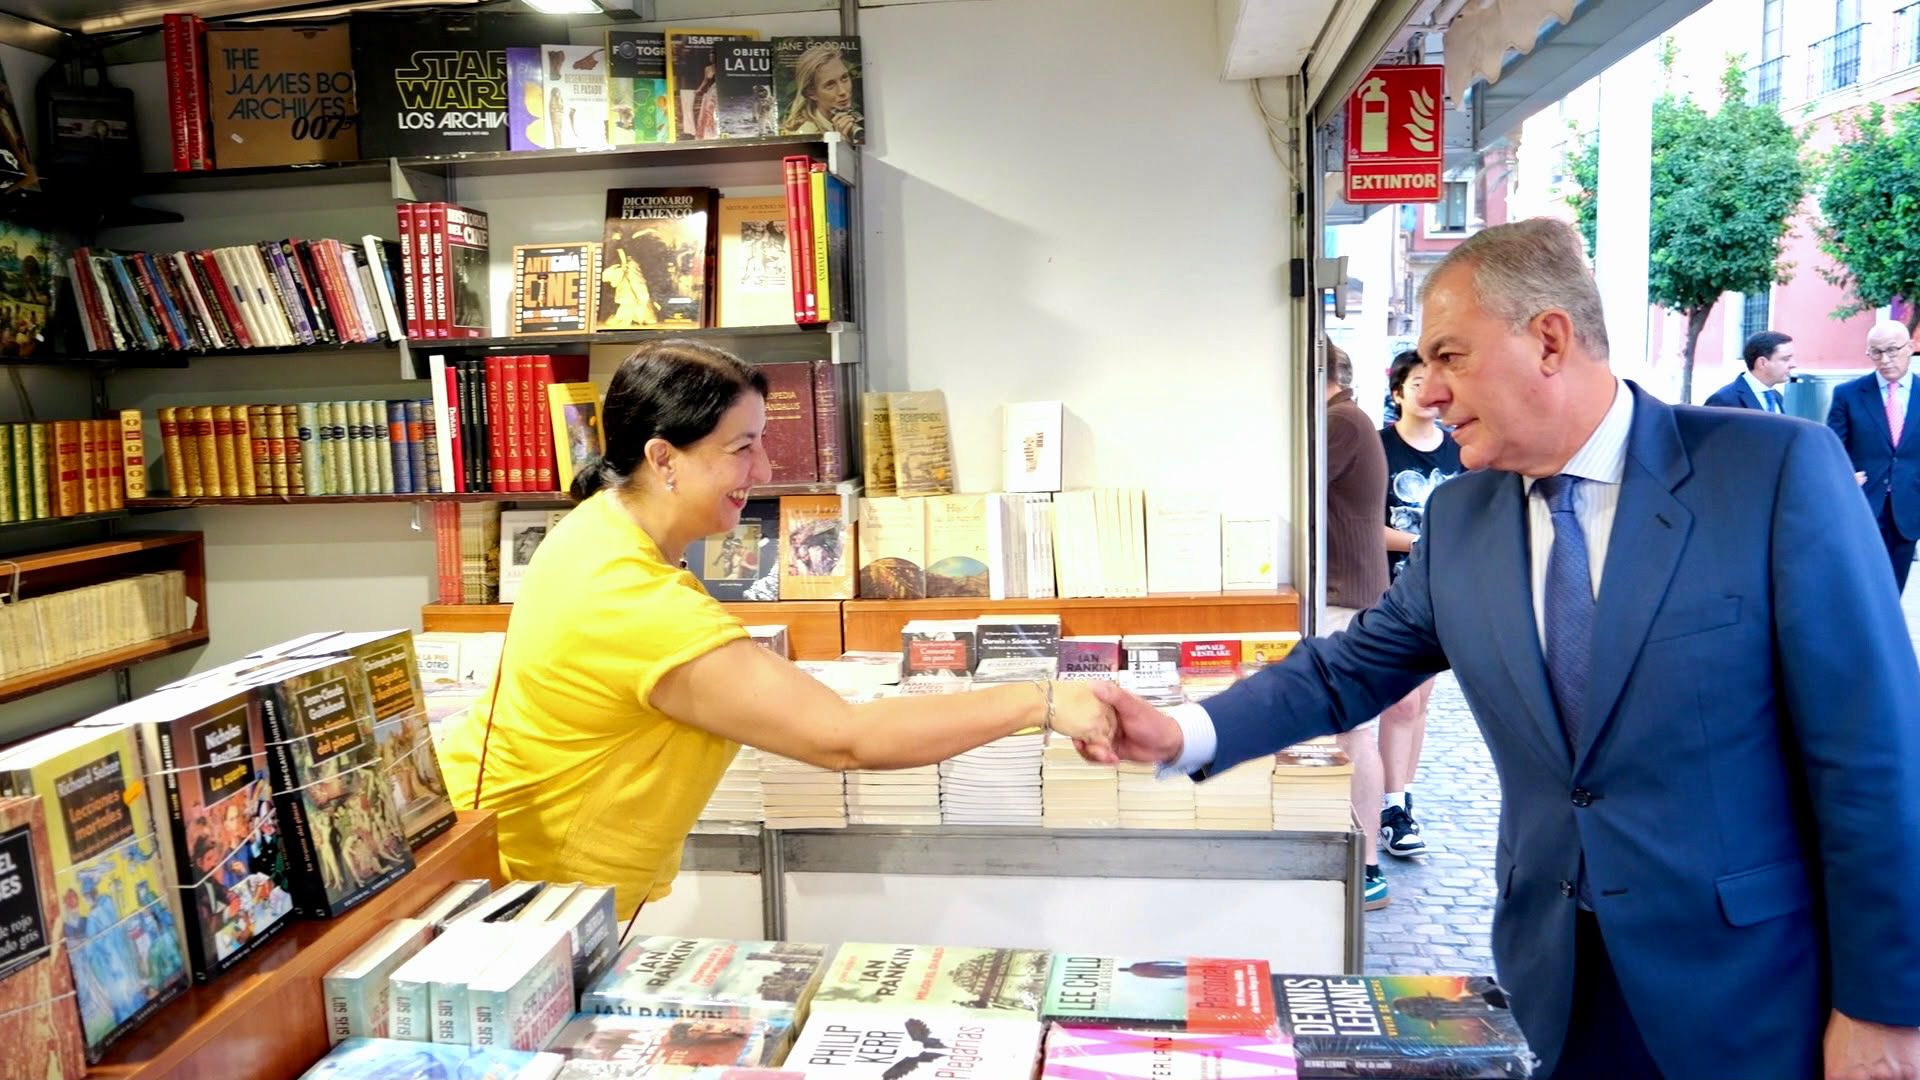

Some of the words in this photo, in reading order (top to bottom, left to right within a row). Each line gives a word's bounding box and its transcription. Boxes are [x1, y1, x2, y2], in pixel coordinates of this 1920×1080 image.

[776, 42, 803, 51] JANE
[806, 42, 858, 51] GOODALL
[222, 48, 260, 70] THE
[724, 58, 745, 71] LA
[225, 73, 311, 95] JAMES
[228, 97, 346, 120] ARCHIVES
[291, 116, 346, 140] 007
[398, 112, 435, 130] LOS
[1351, 174, 1437, 190] EXTINTOR
[623, 195, 693, 207] DICCIONARIO
[447, 208, 488, 229] HISTORIA
[621, 208, 692, 220] FLAMENCO
[401, 233, 410, 255] CINE
[420, 233, 429, 255] CINE
[433, 233, 442, 255] CINE
[447, 223, 464, 236] DEL
[463, 227, 488, 246] CINE
[403, 256, 412, 274] DEL
[421, 256, 431, 274] DEL
[434, 256, 443, 274] DEL
[405, 275, 417, 320] HISTORIA
[423, 275, 434, 320] HISTORIA
[436, 275, 446, 320] HISTORIA
[767, 391, 797, 400] OPEDIA
[489, 380, 502, 458] SEVILLA
[505, 380, 519, 458] SEVILLA
[521, 380, 533, 457] SEVILLA
[537, 380, 548, 457] SEVILLA
[1066, 663, 1112, 672] RANKIN
[1078, 653, 1099, 662] IAN
[0, 852, 16, 876] EL
[0, 875, 22, 900] ES
[10, 916, 32, 936] rojo
[19, 929, 39, 951] gris
[636, 951, 666, 973] IAN
[647, 940, 699, 988] RANKIN
[859, 960, 886, 982] IAN
[876, 948, 914, 997] RANKIN
[1062, 957, 1102, 989] CHILD
[1196, 966, 1230, 1009] Personal
[332, 997, 347, 1013] LOS
[397, 997, 410, 1013] LOS
[439, 1000, 453, 1017] LOS
[1058, 991, 1098, 1011] LEE
[1283, 978, 1336, 1036] DENNIS
[1326, 978, 1382, 1036] LEHANE
[398, 1015, 411, 1036] SEIS
[477, 1006, 491, 1023] LOS
[335, 1016, 350, 1036] SEIS
[440, 1019, 454, 1039] SEIS
[479, 1026, 494, 1046] SEIS
[809, 1025, 861, 1065] PHILIP
[854, 1030, 905, 1064] KERR
